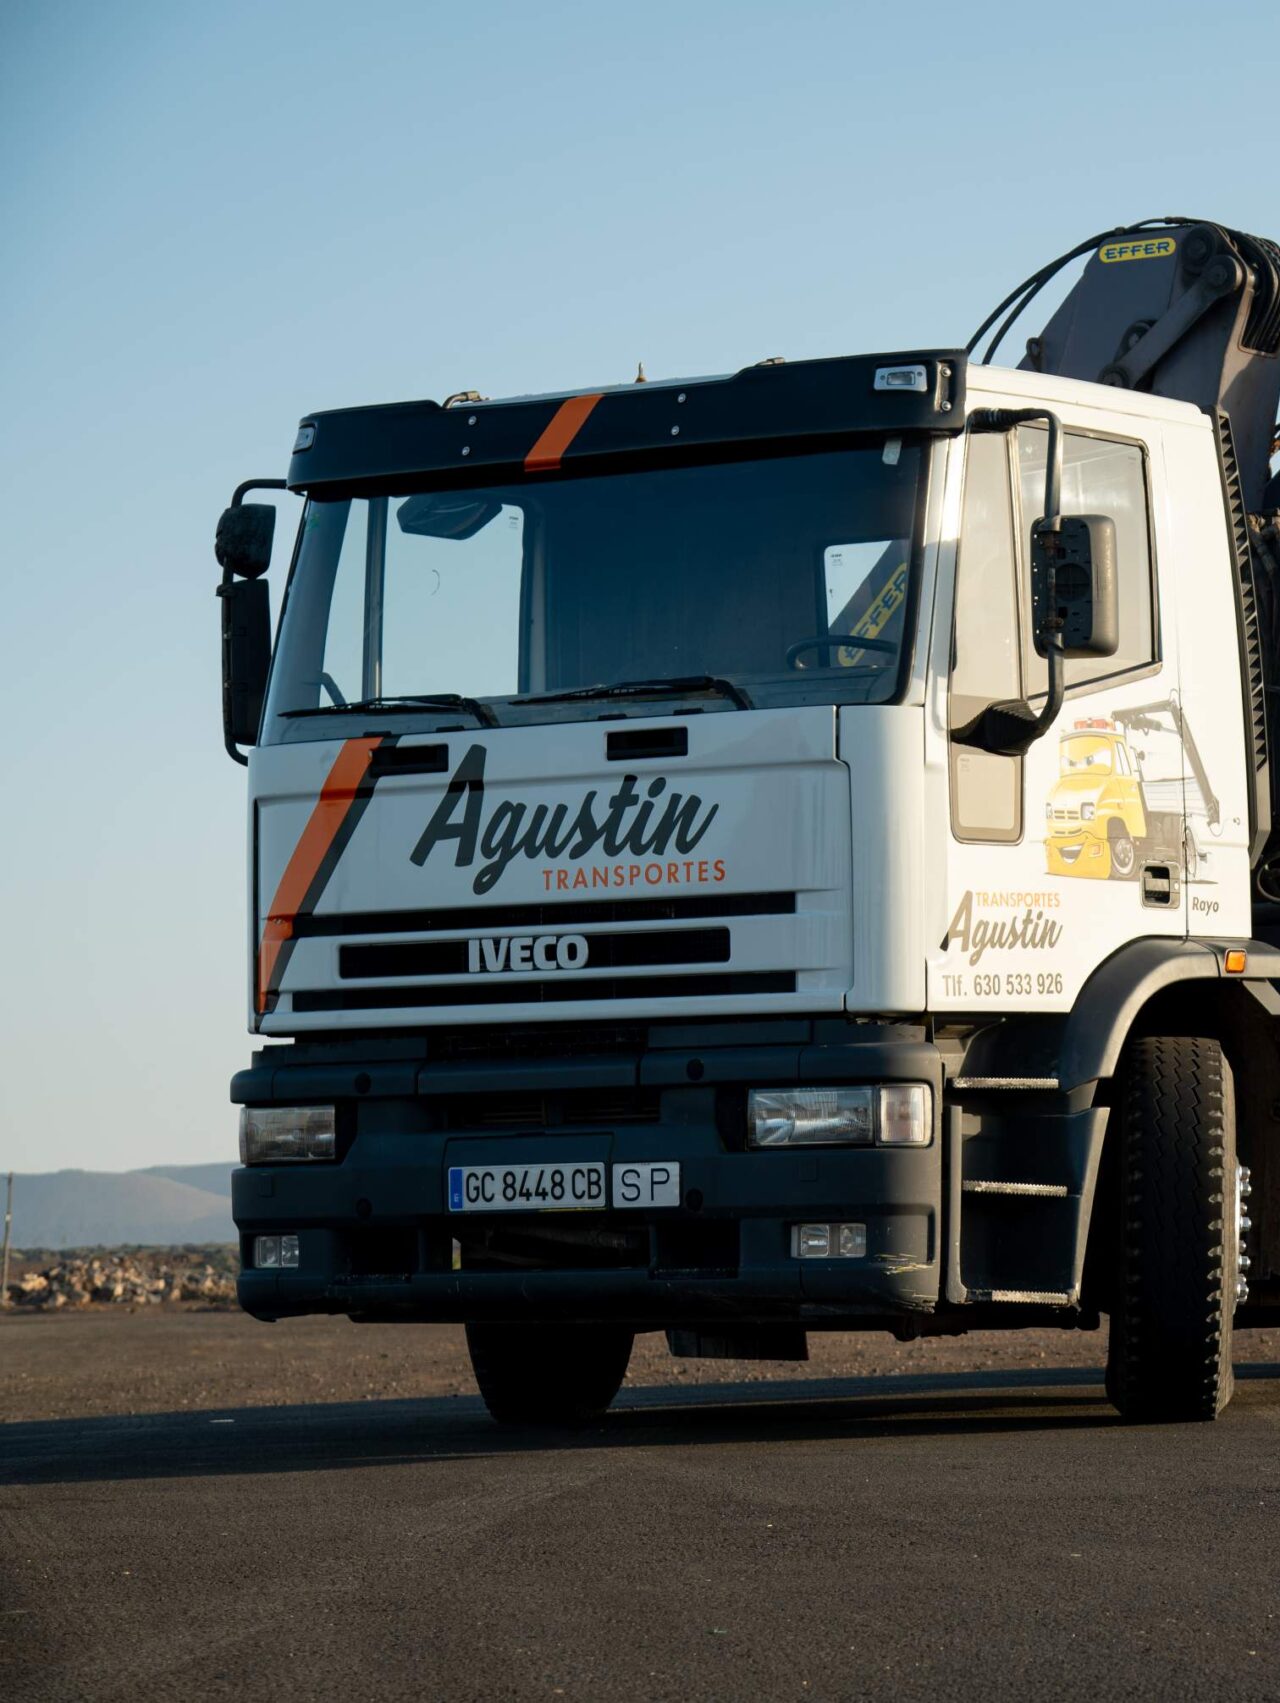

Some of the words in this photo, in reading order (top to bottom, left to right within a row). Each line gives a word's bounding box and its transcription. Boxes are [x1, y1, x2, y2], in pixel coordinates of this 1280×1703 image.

[1105, 241, 1170, 259] EFFER
[409, 744, 719, 896] Agustin
[543, 859, 726, 891] TRANSPORTES
[975, 892, 1060, 908] TRANSPORTES
[939, 890, 1063, 967] Agustin
[468, 934, 589, 973] IVECO
[942, 974, 967, 997] Tlf.
[974, 974, 1001, 996] 630
[1006, 974, 1032, 995] 533
[1037, 973, 1063, 994] 926
[465, 1172, 495, 1202] GC
[502, 1169, 565, 1202] 8448
[571, 1168, 602, 1200] CB
